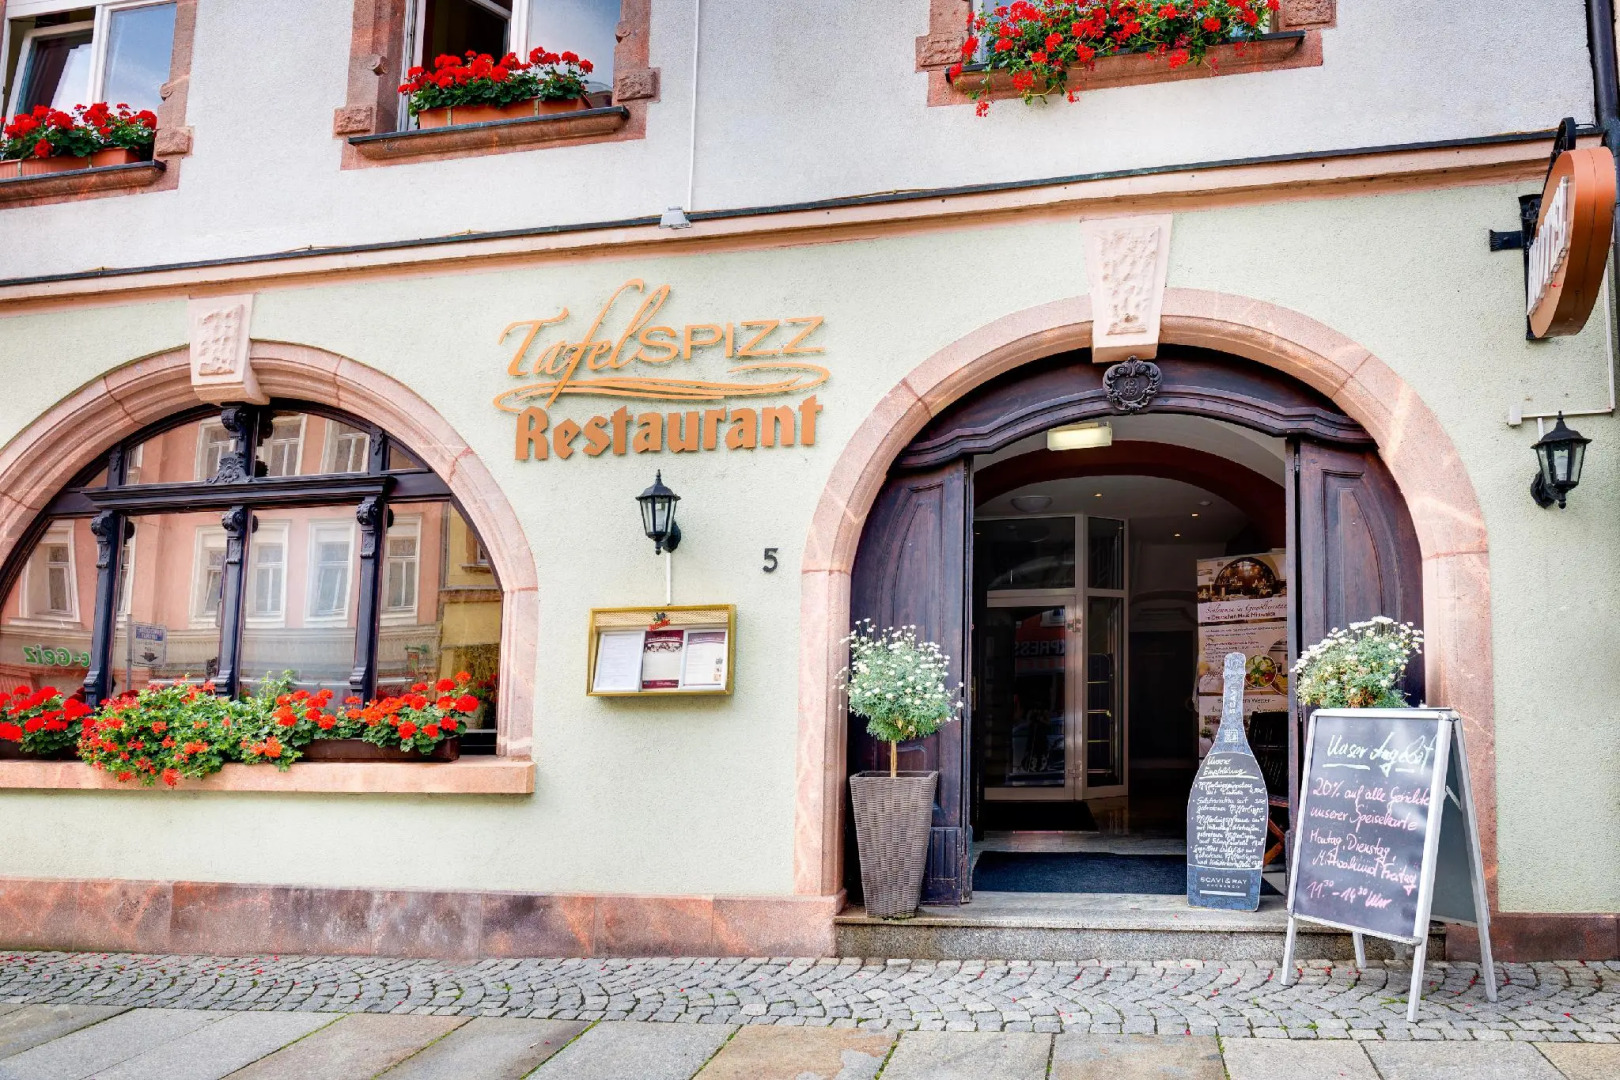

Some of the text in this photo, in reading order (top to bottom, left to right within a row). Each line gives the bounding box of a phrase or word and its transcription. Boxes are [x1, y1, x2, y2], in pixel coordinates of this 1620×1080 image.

[515, 395, 824, 461] Restaurant
[762, 547, 779, 573] 5
[1327, 734, 1369, 760] Unser
[1312, 777, 1344, 798] 20%
[1344, 785, 1364, 807] auf
[1365, 787, 1386, 802] alle
[1310, 804, 1417, 832] unserer Speisekarte
